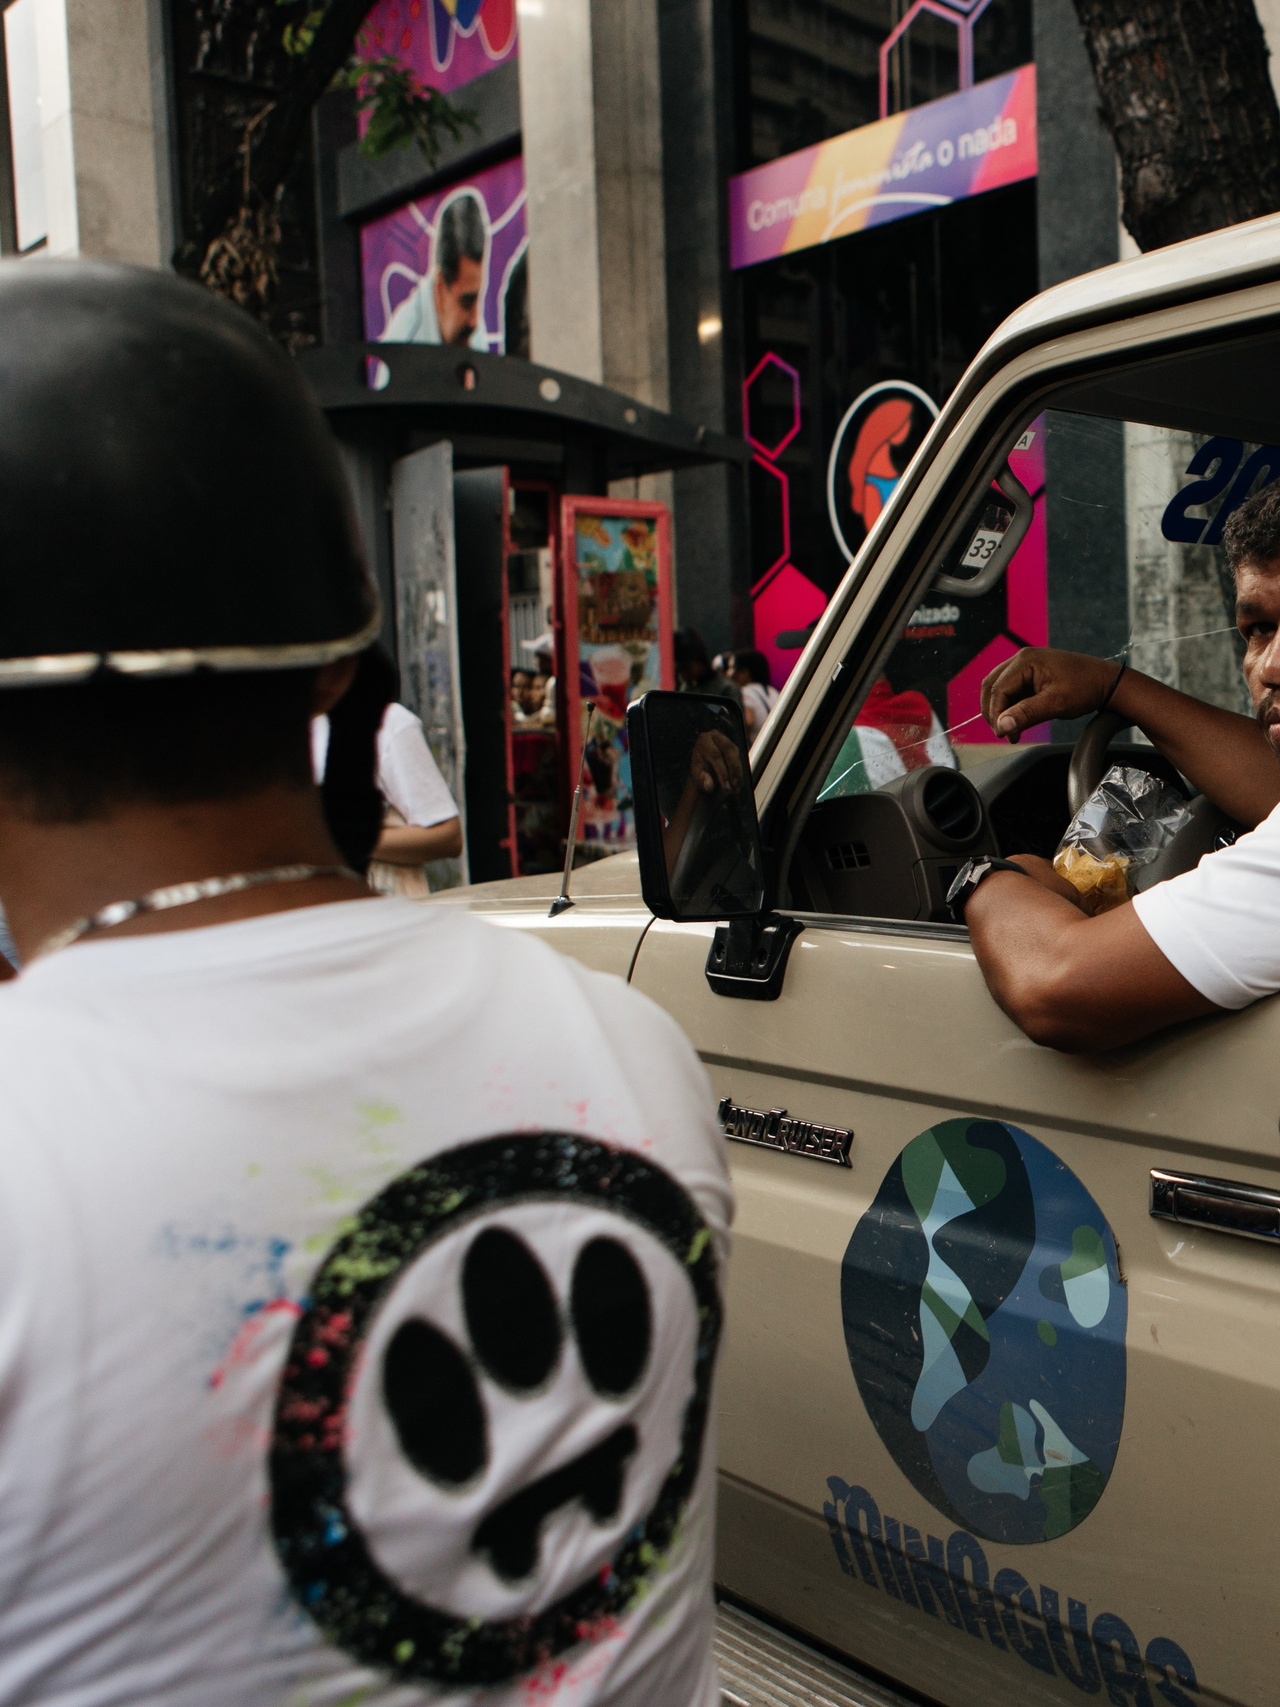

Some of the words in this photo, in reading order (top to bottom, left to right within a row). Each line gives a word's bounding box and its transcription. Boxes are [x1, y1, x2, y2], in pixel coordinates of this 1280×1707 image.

[748, 185, 827, 232] Comuna
[937, 142, 954, 167] o
[958, 116, 1017, 161] nada
[969, 537, 997, 559] 33
